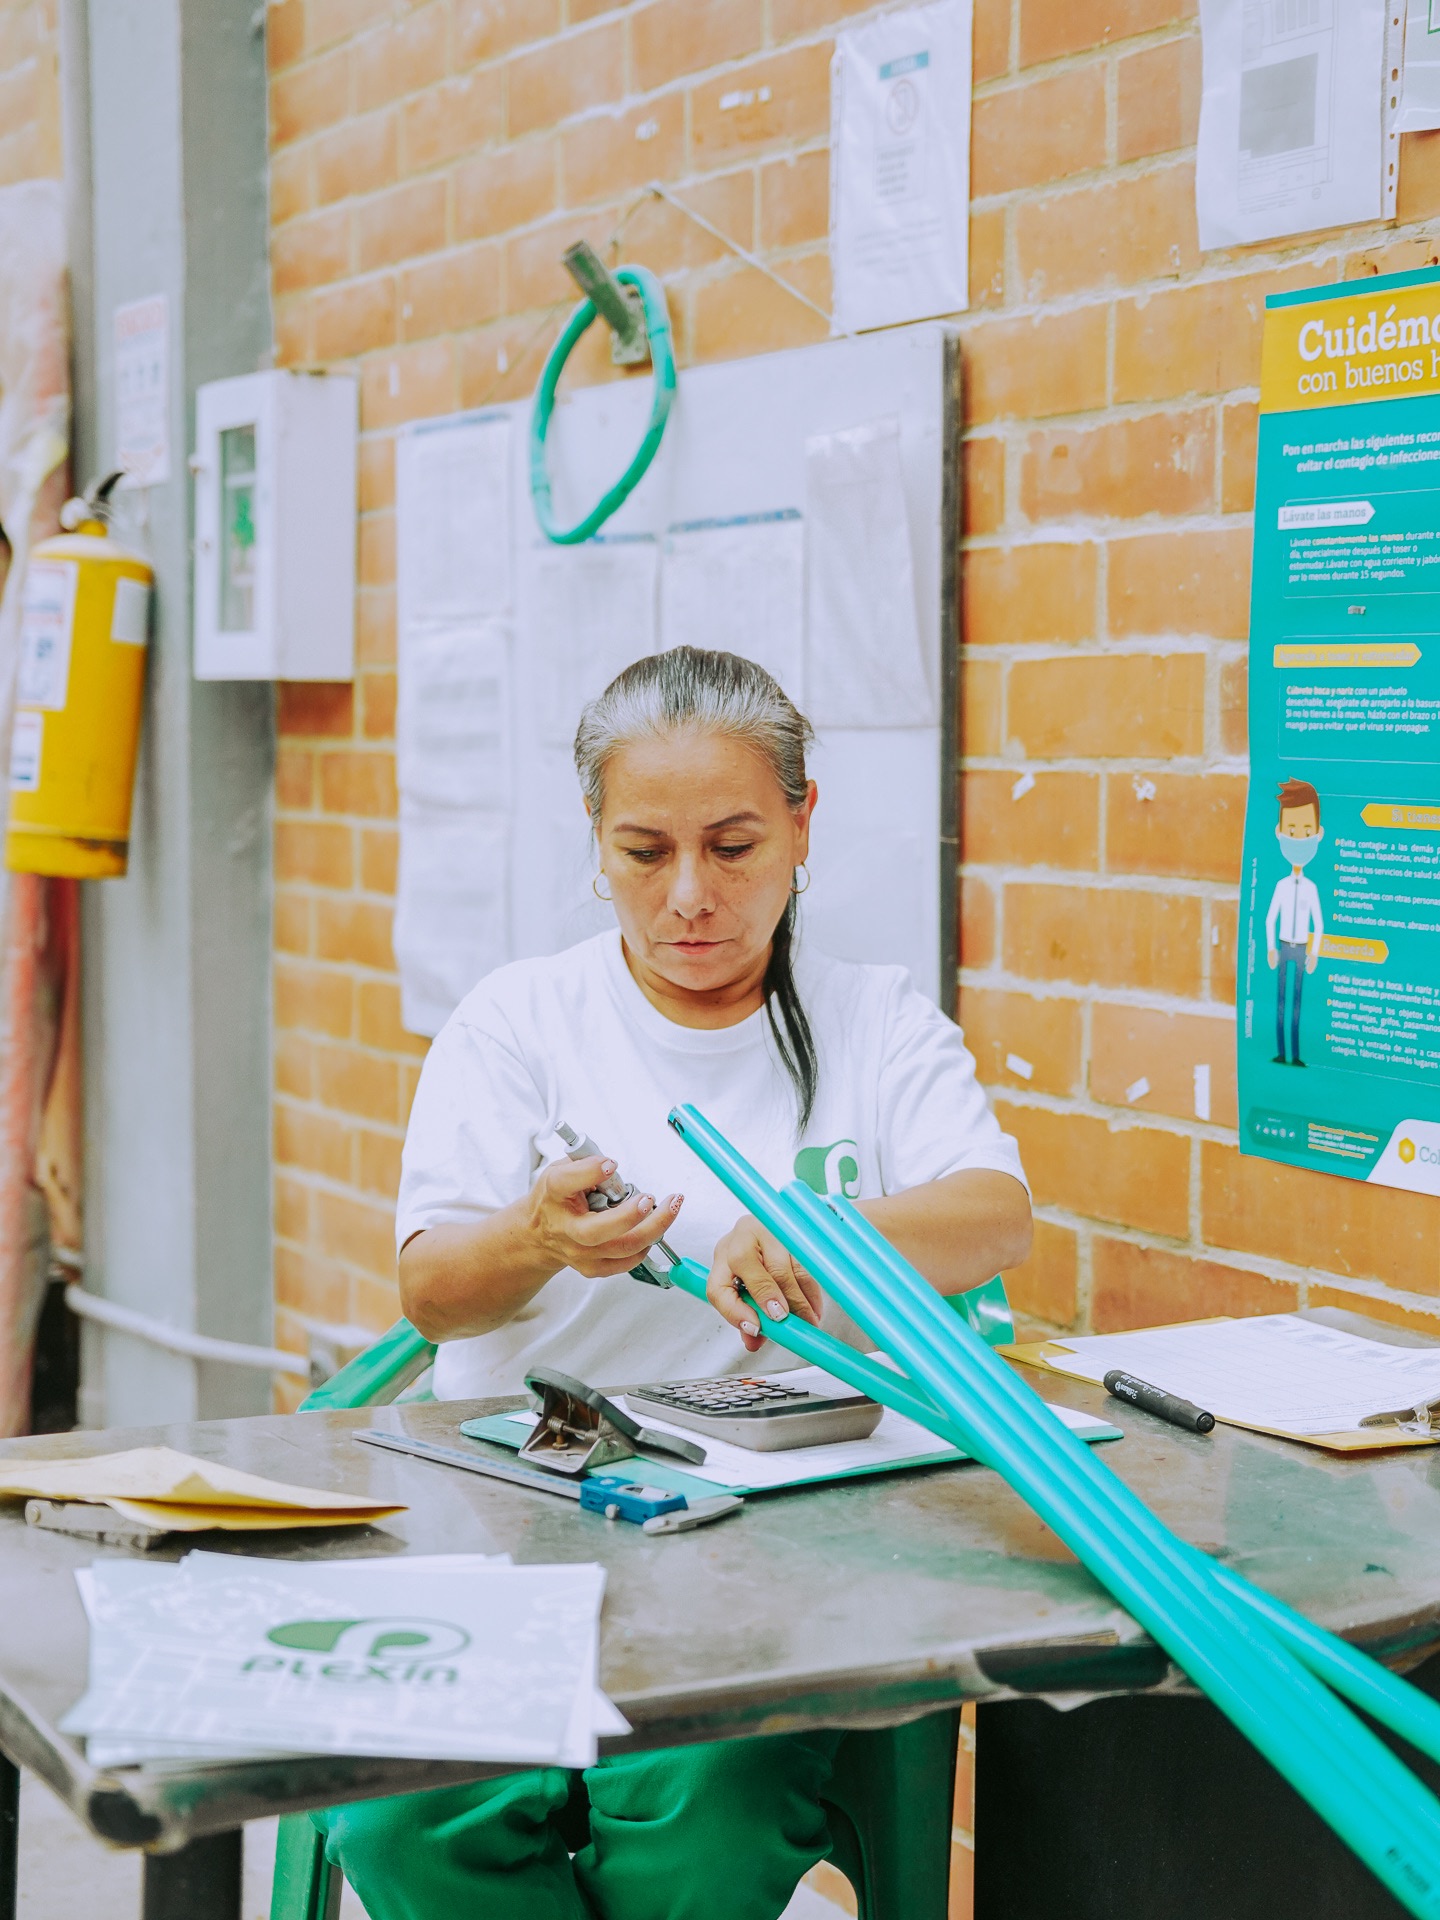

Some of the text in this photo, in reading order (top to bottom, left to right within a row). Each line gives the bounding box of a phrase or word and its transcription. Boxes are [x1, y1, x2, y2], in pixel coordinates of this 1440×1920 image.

[1298, 371, 1338, 395] con
[1344, 359, 1424, 389] buenos
[1282, 444, 1300, 456] Pon
[1302, 444, 1314, 455] en
[1315, 438, 1349, 453] marcha
[1351, 437, 1364, 450] las
[1365, 433, 1415, 452] siguientes
[1296, 449, 1440, 473] evitar el contagio de infeccione
[1283, 508, 1367, 523] Lávate las manos
[1391, 808, 1404, 823] Si
[1323, 938, 1375, 957] Recuerda
